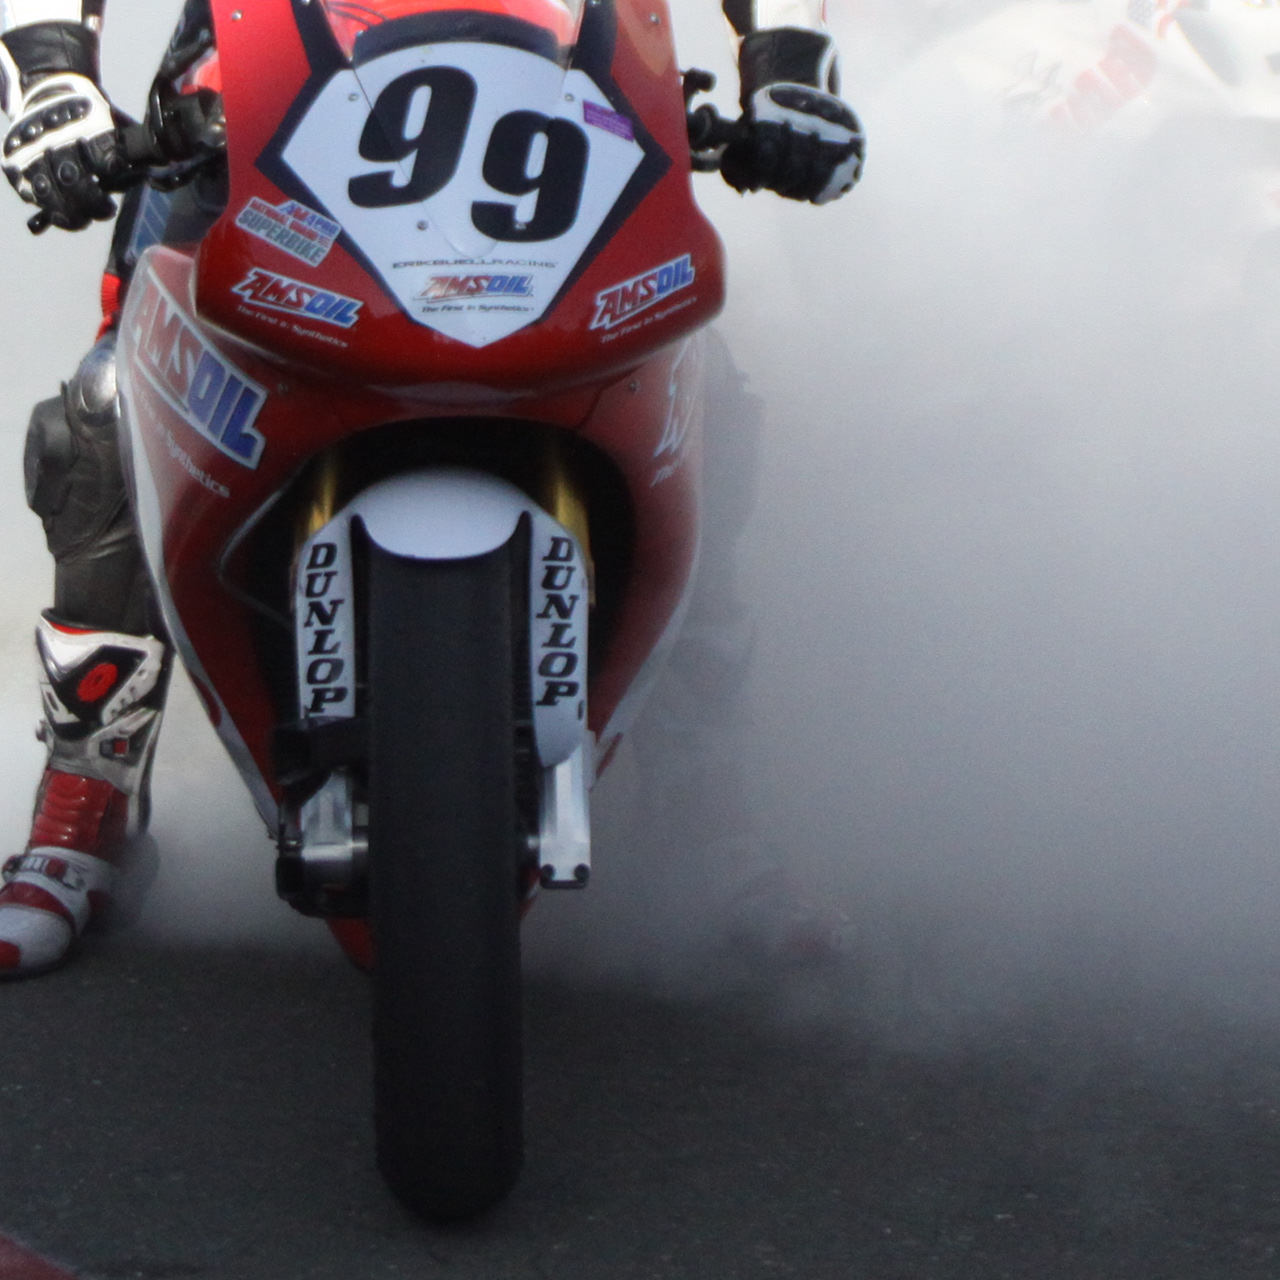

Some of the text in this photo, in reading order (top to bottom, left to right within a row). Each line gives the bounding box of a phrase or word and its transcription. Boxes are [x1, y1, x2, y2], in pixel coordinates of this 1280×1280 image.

[348, 65, 590, 243] 99
[238, 209, 326, 264] SUPERBIKE
[234, 270, 360, 326] AMSOIL
[418, 274, 532, 300] AMSOIL
[592, 256, 694, 329] AMSOIL
[128, 280, 261, 461] AMSOIL
[291, 324, 348, 348] Synthetics
[304, 542, 348, 714] DUNLOP
[536, 536, 580, 707] DUNLOP
